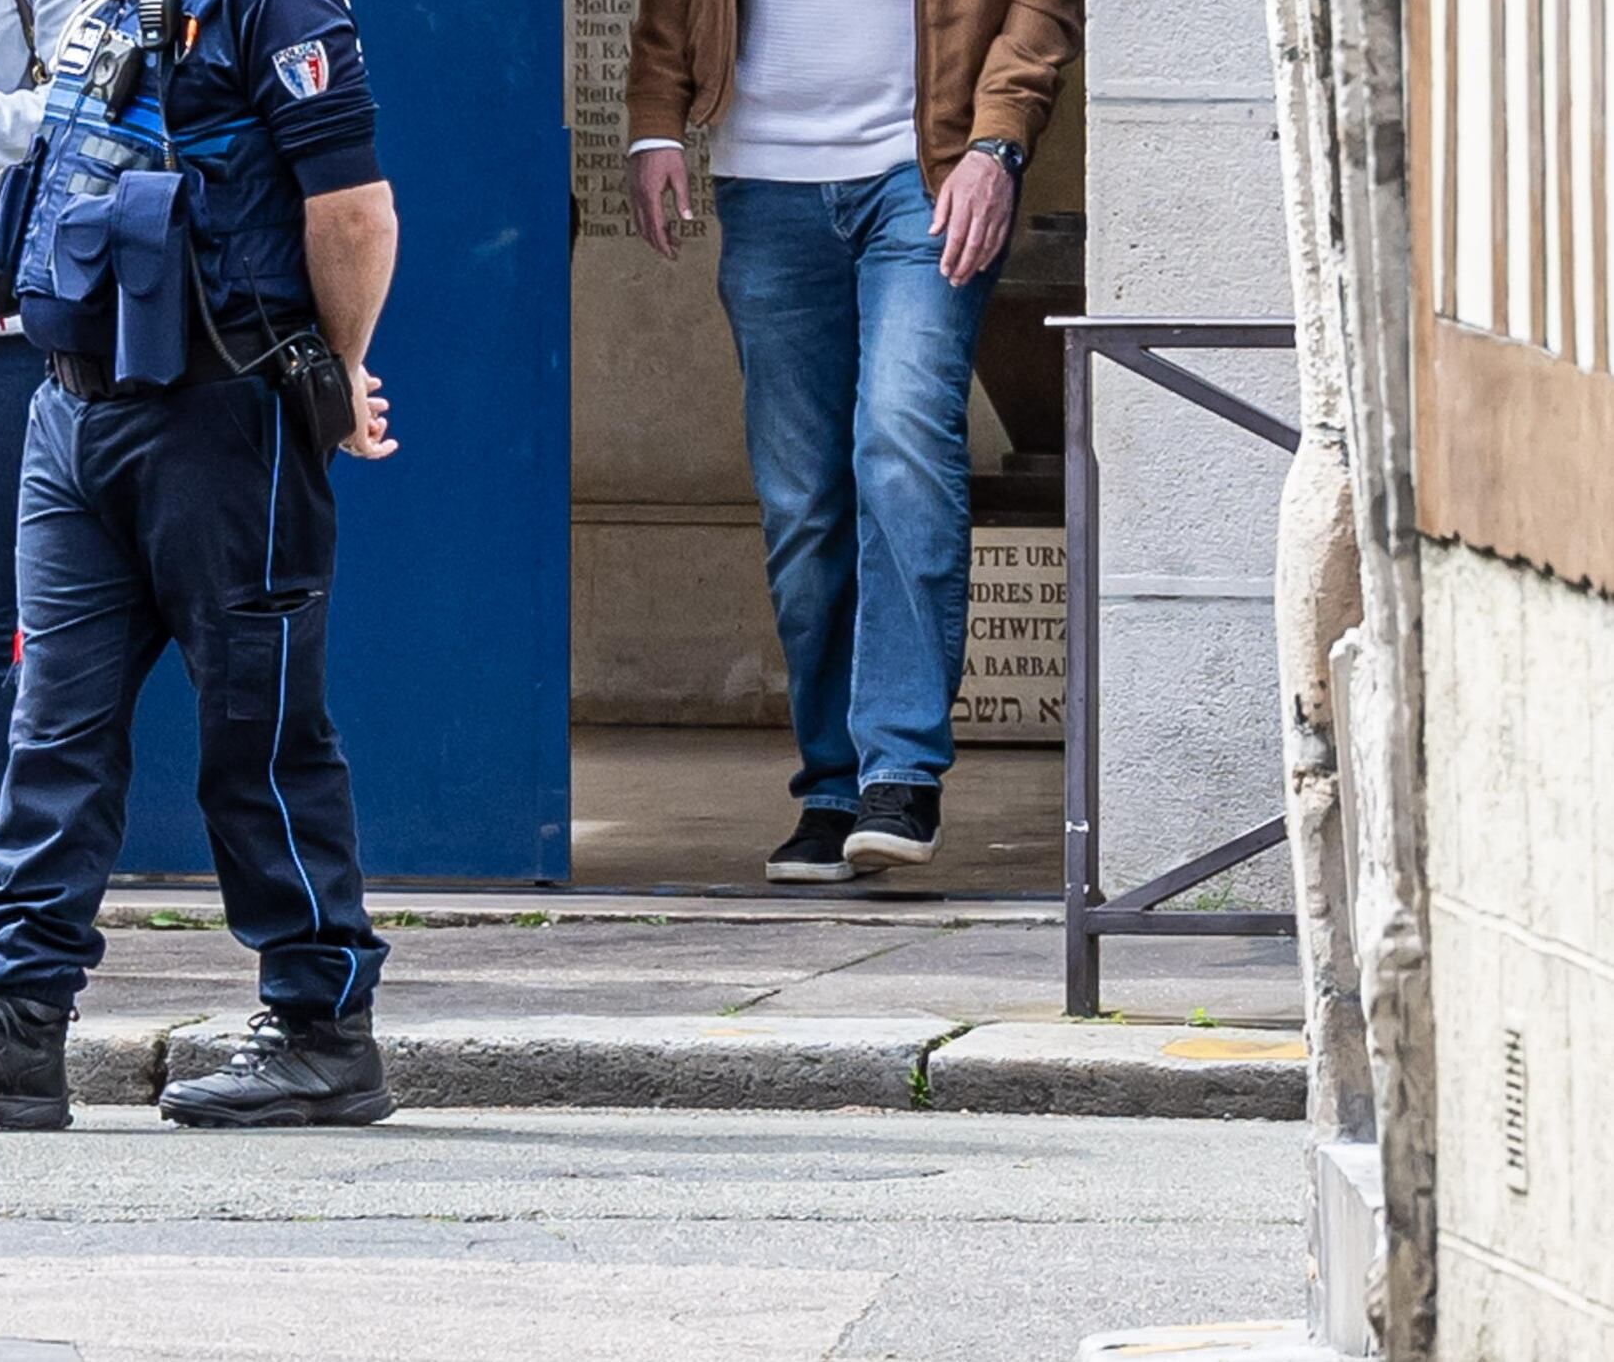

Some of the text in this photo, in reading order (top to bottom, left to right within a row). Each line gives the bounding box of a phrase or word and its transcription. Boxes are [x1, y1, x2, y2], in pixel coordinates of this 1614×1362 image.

[575, 19, 623, 36] Mme
[575, 109, 622, 125] Mme
[575, 130, 620, 147] Mme
[971, 546, 1018, 567] TTE
[967, 617, 1066, 640] CHWITZ
[984, 656, 1066, 677] BARBA
